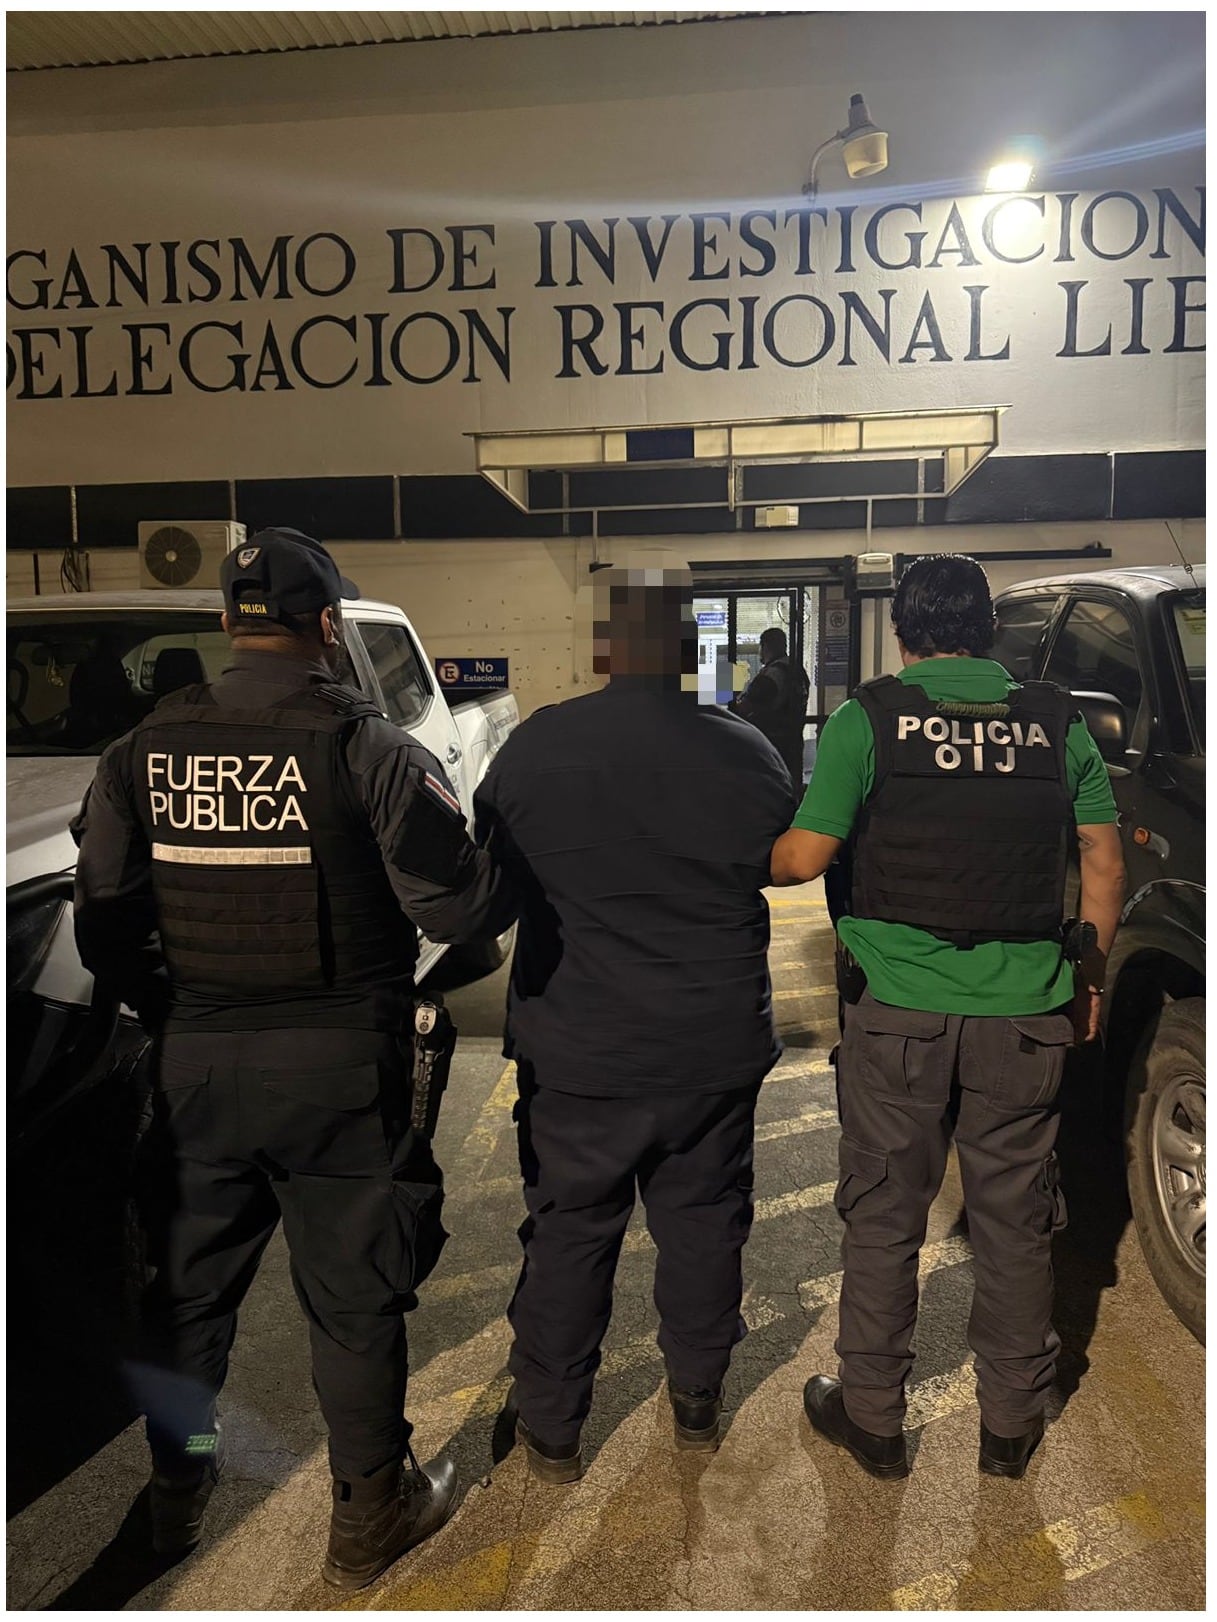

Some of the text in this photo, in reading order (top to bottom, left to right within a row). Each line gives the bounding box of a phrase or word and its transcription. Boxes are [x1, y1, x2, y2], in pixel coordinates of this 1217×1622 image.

[387, 224, 496, 293] DE
[535, 186, 1206, 288] INVESTIGACION
[6, 307, 516, 400] ELEGACION
[553, 285, 1010, 378] REGIONAL
[239, 603, 267, 614] POLICIA
[463, 674, 505, 682] Estacionar
[475, 661, 494, 673] No
[897, 715, 1052, 748] POLICIA
[147, 752, 308, 793] FUERZA
[149, 790, 309, 832] PUBLICA
